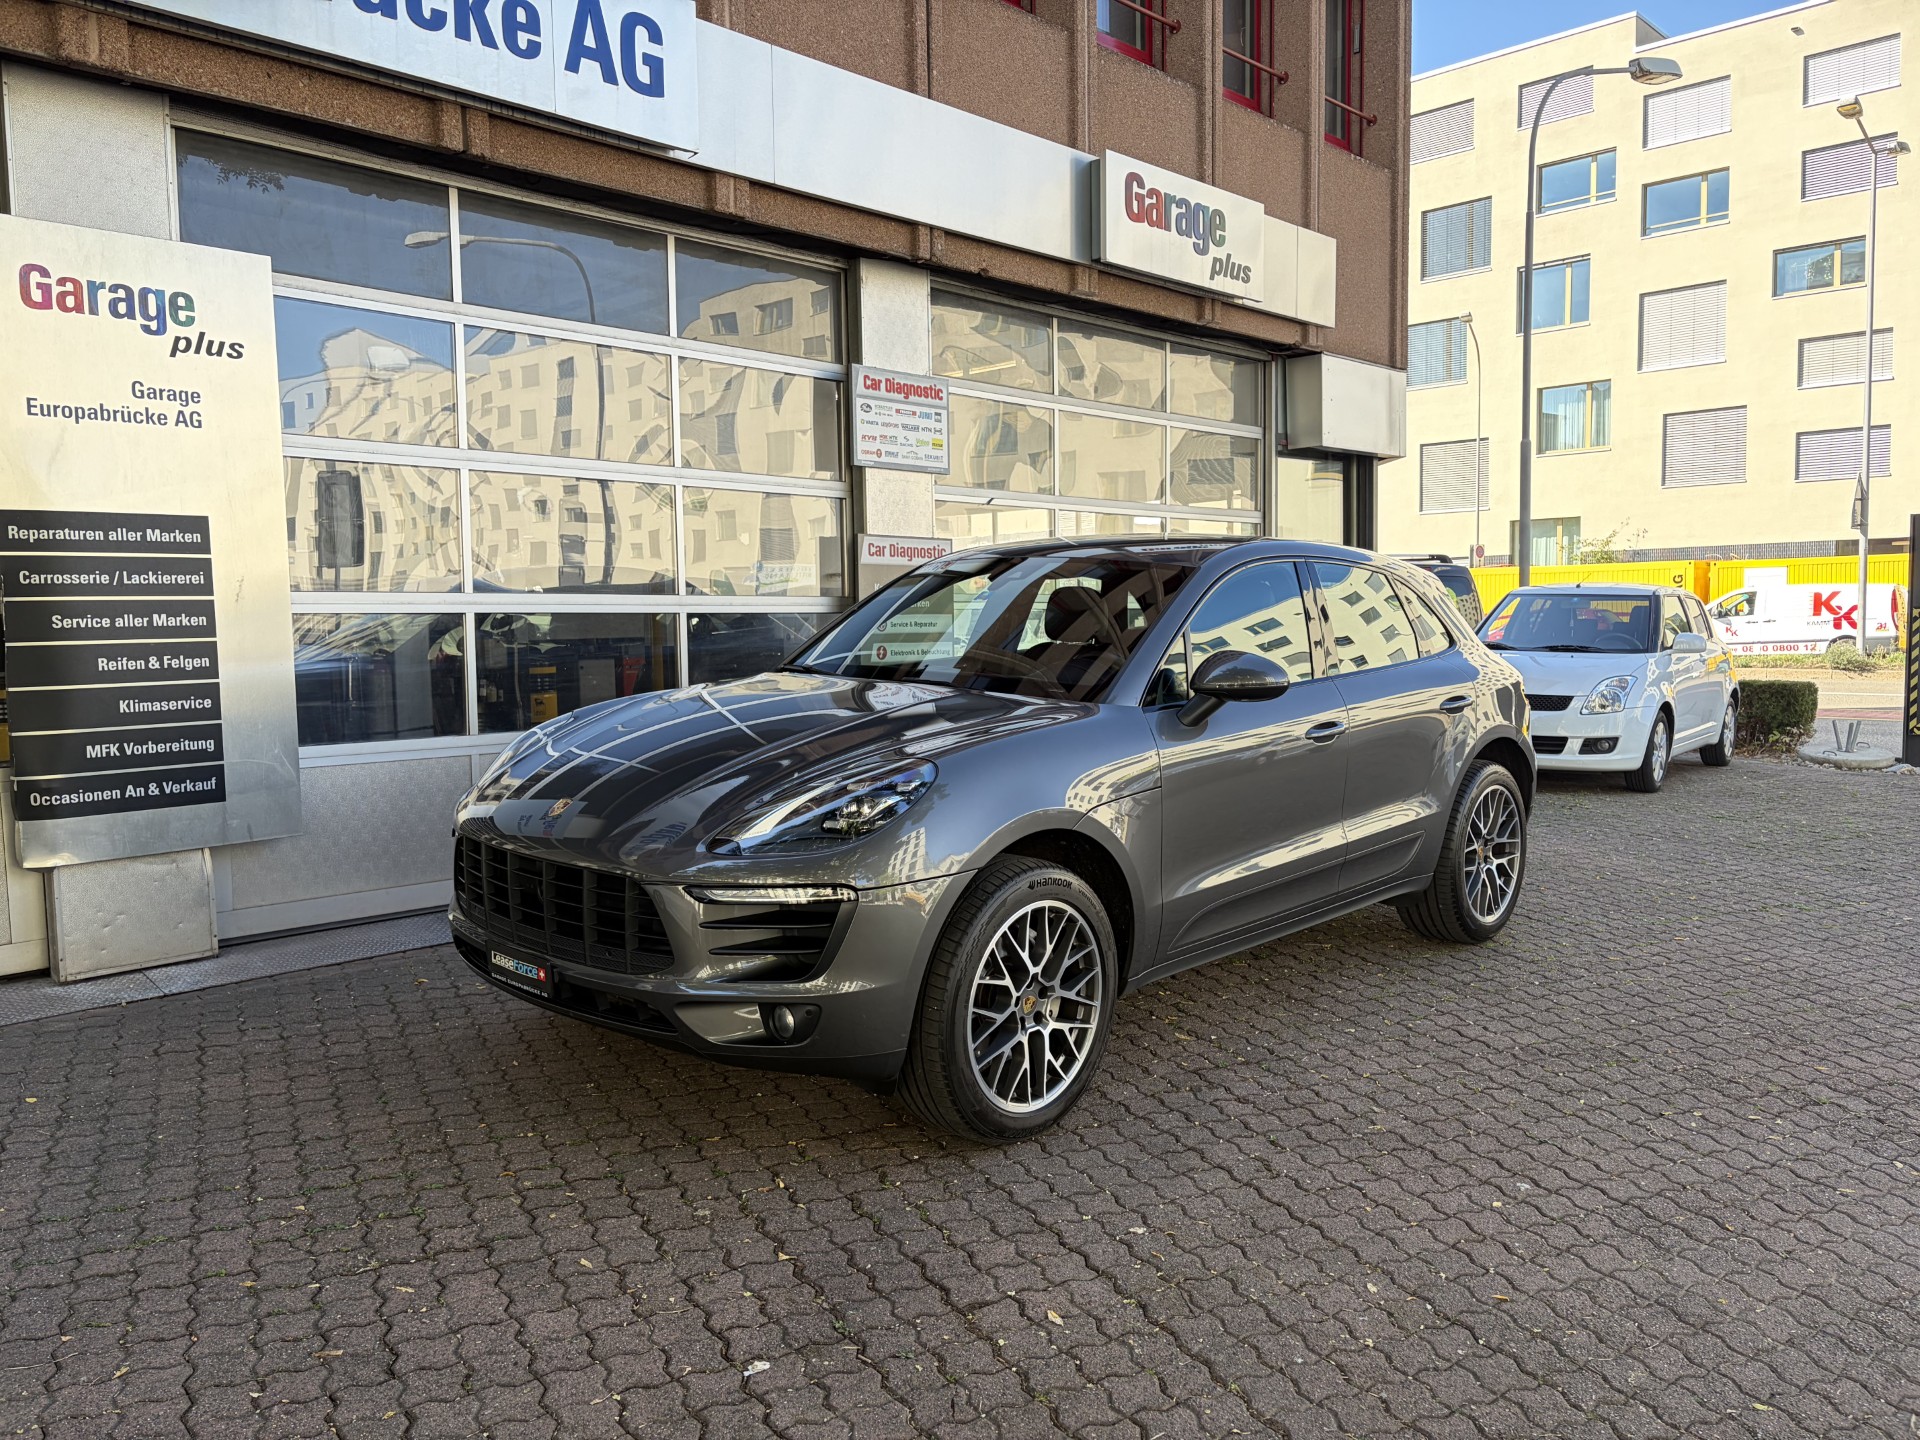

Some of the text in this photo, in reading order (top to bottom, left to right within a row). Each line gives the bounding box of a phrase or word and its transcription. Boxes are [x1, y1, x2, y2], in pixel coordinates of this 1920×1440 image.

[564, 0, 665, 98] AG
[1124, 171, 1227, 256] Garage
[1209, 253, 1252, 284] plus
[18, 263, 196, 336] Garage
[169, 331, 245, 359] plus
[131, 380, 201, 407] Garage
[863, 374, 944, 401] Car Diagnostic
[26, 396, 203, 429] Europabrücke AG
[7, 525, 202, 543] Reparaturen aller Marken
[868, 542, 886, 557] Car
[19, 570, 204, 585] Carrosserie / Lackiererei
[51, 613, 207, 629] Service aller Marken
[914, 621, 938, 630] Reparatur
[890, 648, 916, 656] Elektronik
[921, 648, 951, 656] Beleuchtung
[1772, 644, 1799, 652] 0800
[98, 655, 210, 671] Reifen & Felgen
[119, 696, 212, 713] Klimaservice
[86, 738, 215, 759] MFK Vorbereitung
[30, 776, 217, 806] Occasionen An & Verkauf
[491, 950, 538, 979] LeaseForce
